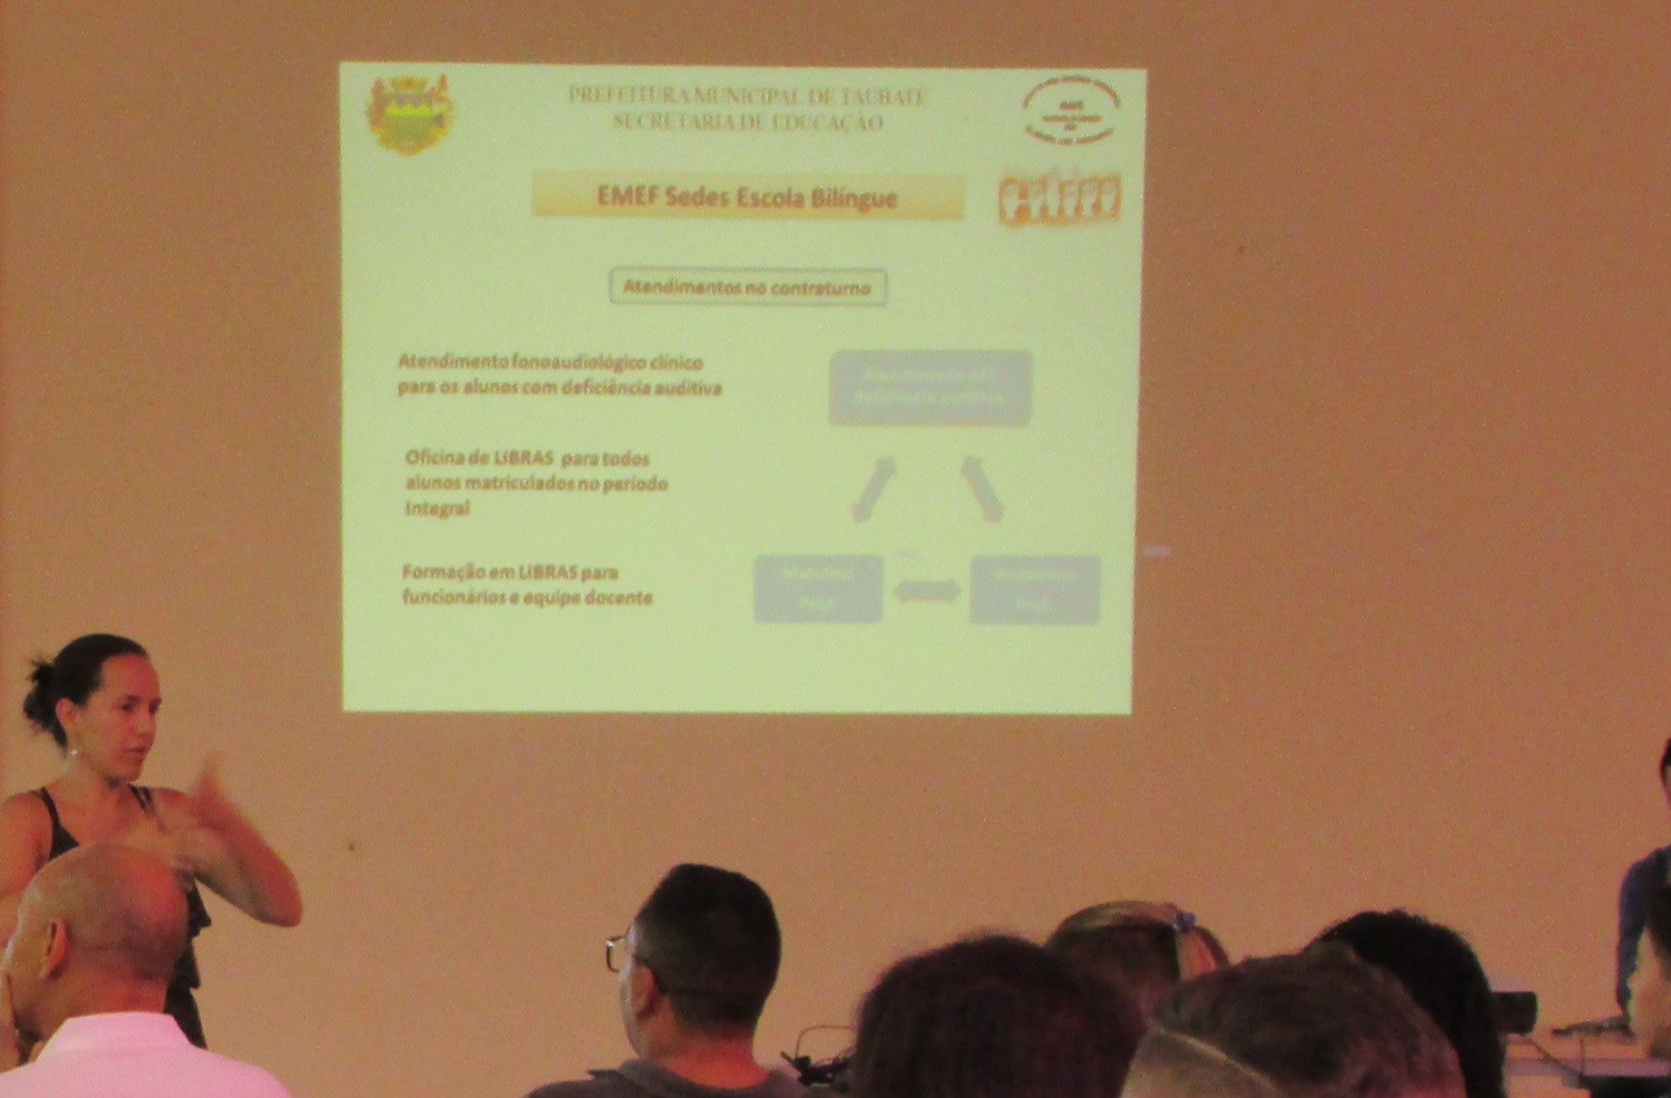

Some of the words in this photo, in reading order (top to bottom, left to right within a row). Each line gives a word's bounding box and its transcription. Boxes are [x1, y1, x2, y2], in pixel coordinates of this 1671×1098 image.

[568, 86, 689, 104] PREFEITURA
[693, 86, 799, 106] MUNICIPAL
[809, 87, 832, 106] DE
[613, 112, 735, 131] SECRETARIA
[740, 113, 764, 131] DE
[772, 109, 884, 133] EDUCAÇÃO
[598, 185, 659, 206] EMEF
[665, 185, 728, 207] Sedes
[737, 186, 806, 208] Escola
[623, 278, 741, 295] Atendimentos
[745, 282, 767, 296] no
[770, 281, 872, 297] contraturno
[398, 353, 509, 371] Atendimento
[398, 381, 436, 397] para
[439, 382, 458, 395] os
[463, 379, 519, 395] alunos
[522, 382, 558, 395] com
[561, 379, 651, 396] deficiência
[654, 380, 723, 397] auditiva
[405, 449, 465, 467] Oficina
[468, 449, 490, 466] de
[494, 450, 554, 467] LIBRAS
[561, 453, 599, 470] para
[602, 451, 650, 468] todos
[405, 475, 462, 491] alunos
[465, 475, 574, 491] matriculados
[578, 478, 600, 491] no
[405, 500, 471, 520] Integral
[402, 563, 485, 583] Formação
[489, 568, 516, 580] em
[518, 565, 578, 581] LIBRAS
[580, 567, 618, 583] para
[402, 588, 506, 606] funcionários
[509, 592, 520, 606] e
[523, 590, 581, 608] equipe
[584, 589, 654, 606] docente
